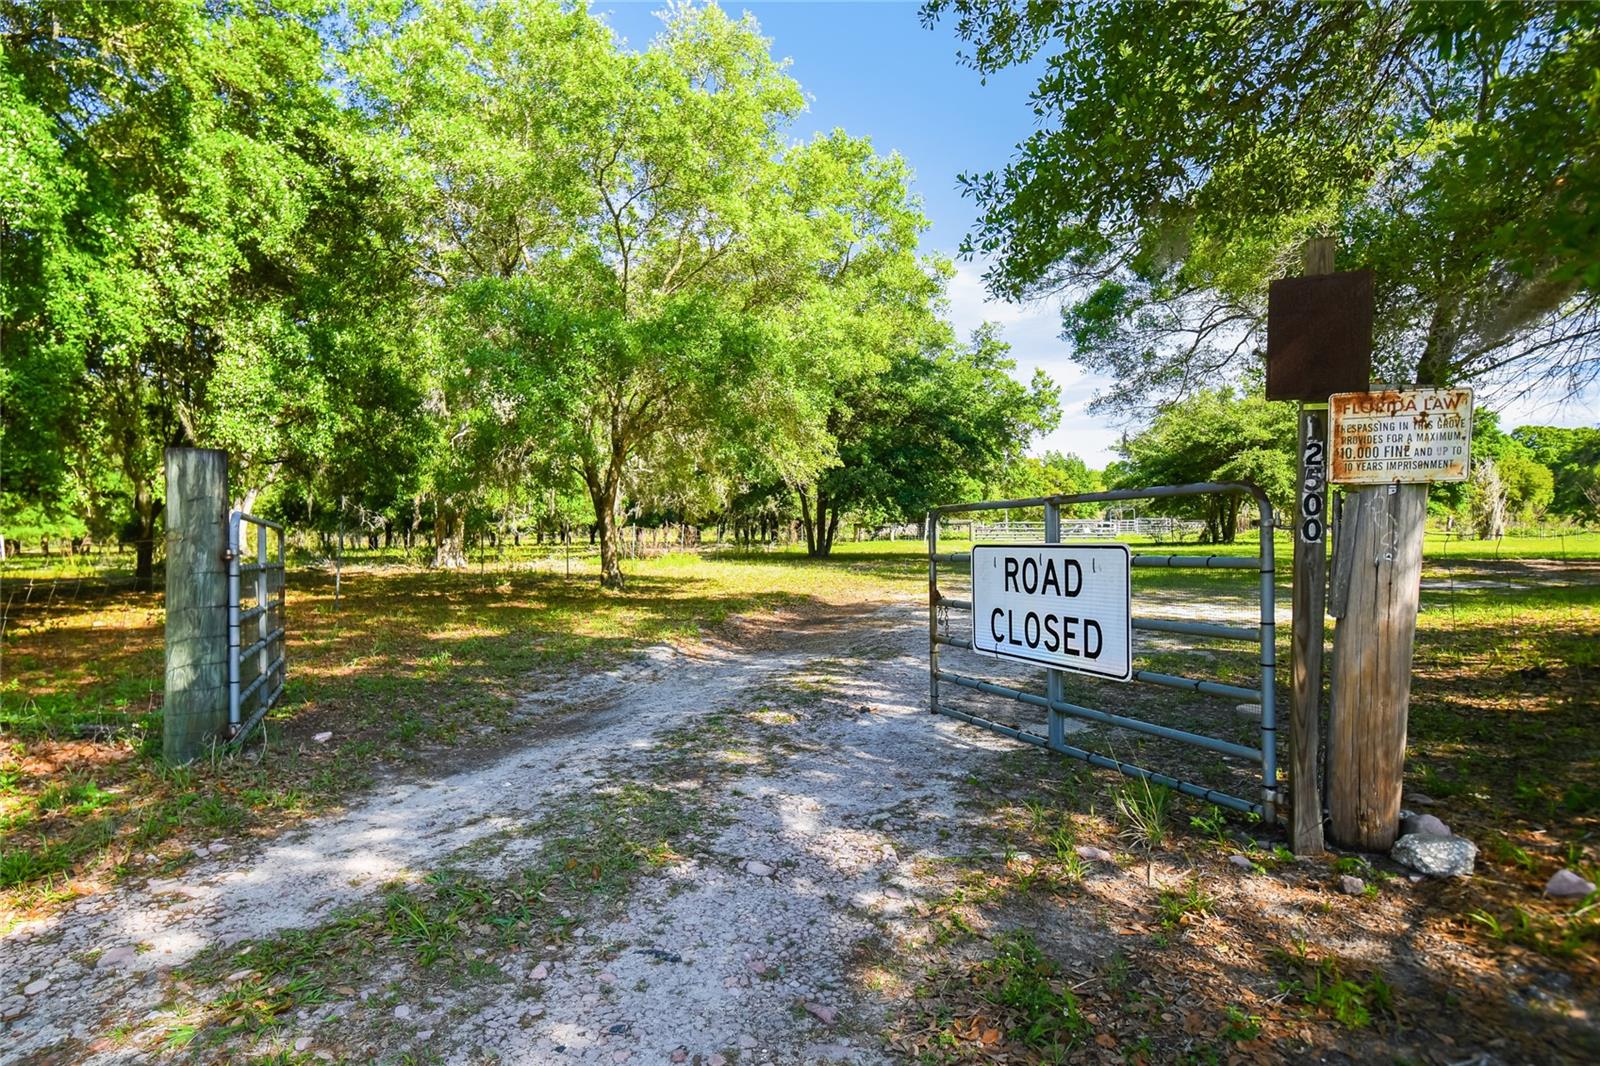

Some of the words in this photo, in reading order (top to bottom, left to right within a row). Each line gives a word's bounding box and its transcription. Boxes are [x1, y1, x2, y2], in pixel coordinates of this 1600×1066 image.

[1343, 398, 1417, 414] FLORIDA
[1424, 397, 1460, 411] LAW
[1336, 422, 1395, 434] TRESPASSING
[1398, 421, 1408, 431] IN
[1414, 419, 1433, 430] THIS
[1437, 418, 1466, 429] GROVE
[1341, 434, 1383, 445] PROVIDES
[1386, 434, 1404, 443] FOR
[1407, 433, 1413, 442] A
[1416, 431, 1461, 442] MAXIMUM
[1384, 445, 1410, 458] FINE
[1414, 447, 1433, 457] AND
[1436, 446, 1449, 456] UP
[1452, 446, 1462, 455] TO
[1344, 463, 1353, 473] 10
[1356, 461, 1383, 471] YEARS
[1386, 459, 1454, 471] IMPRISONMENT
[1302, 415, 1322, 542] 12500
[1004, 557, 1083, 598] ROAD
[991, 607, 1103, 660] CLOSED
